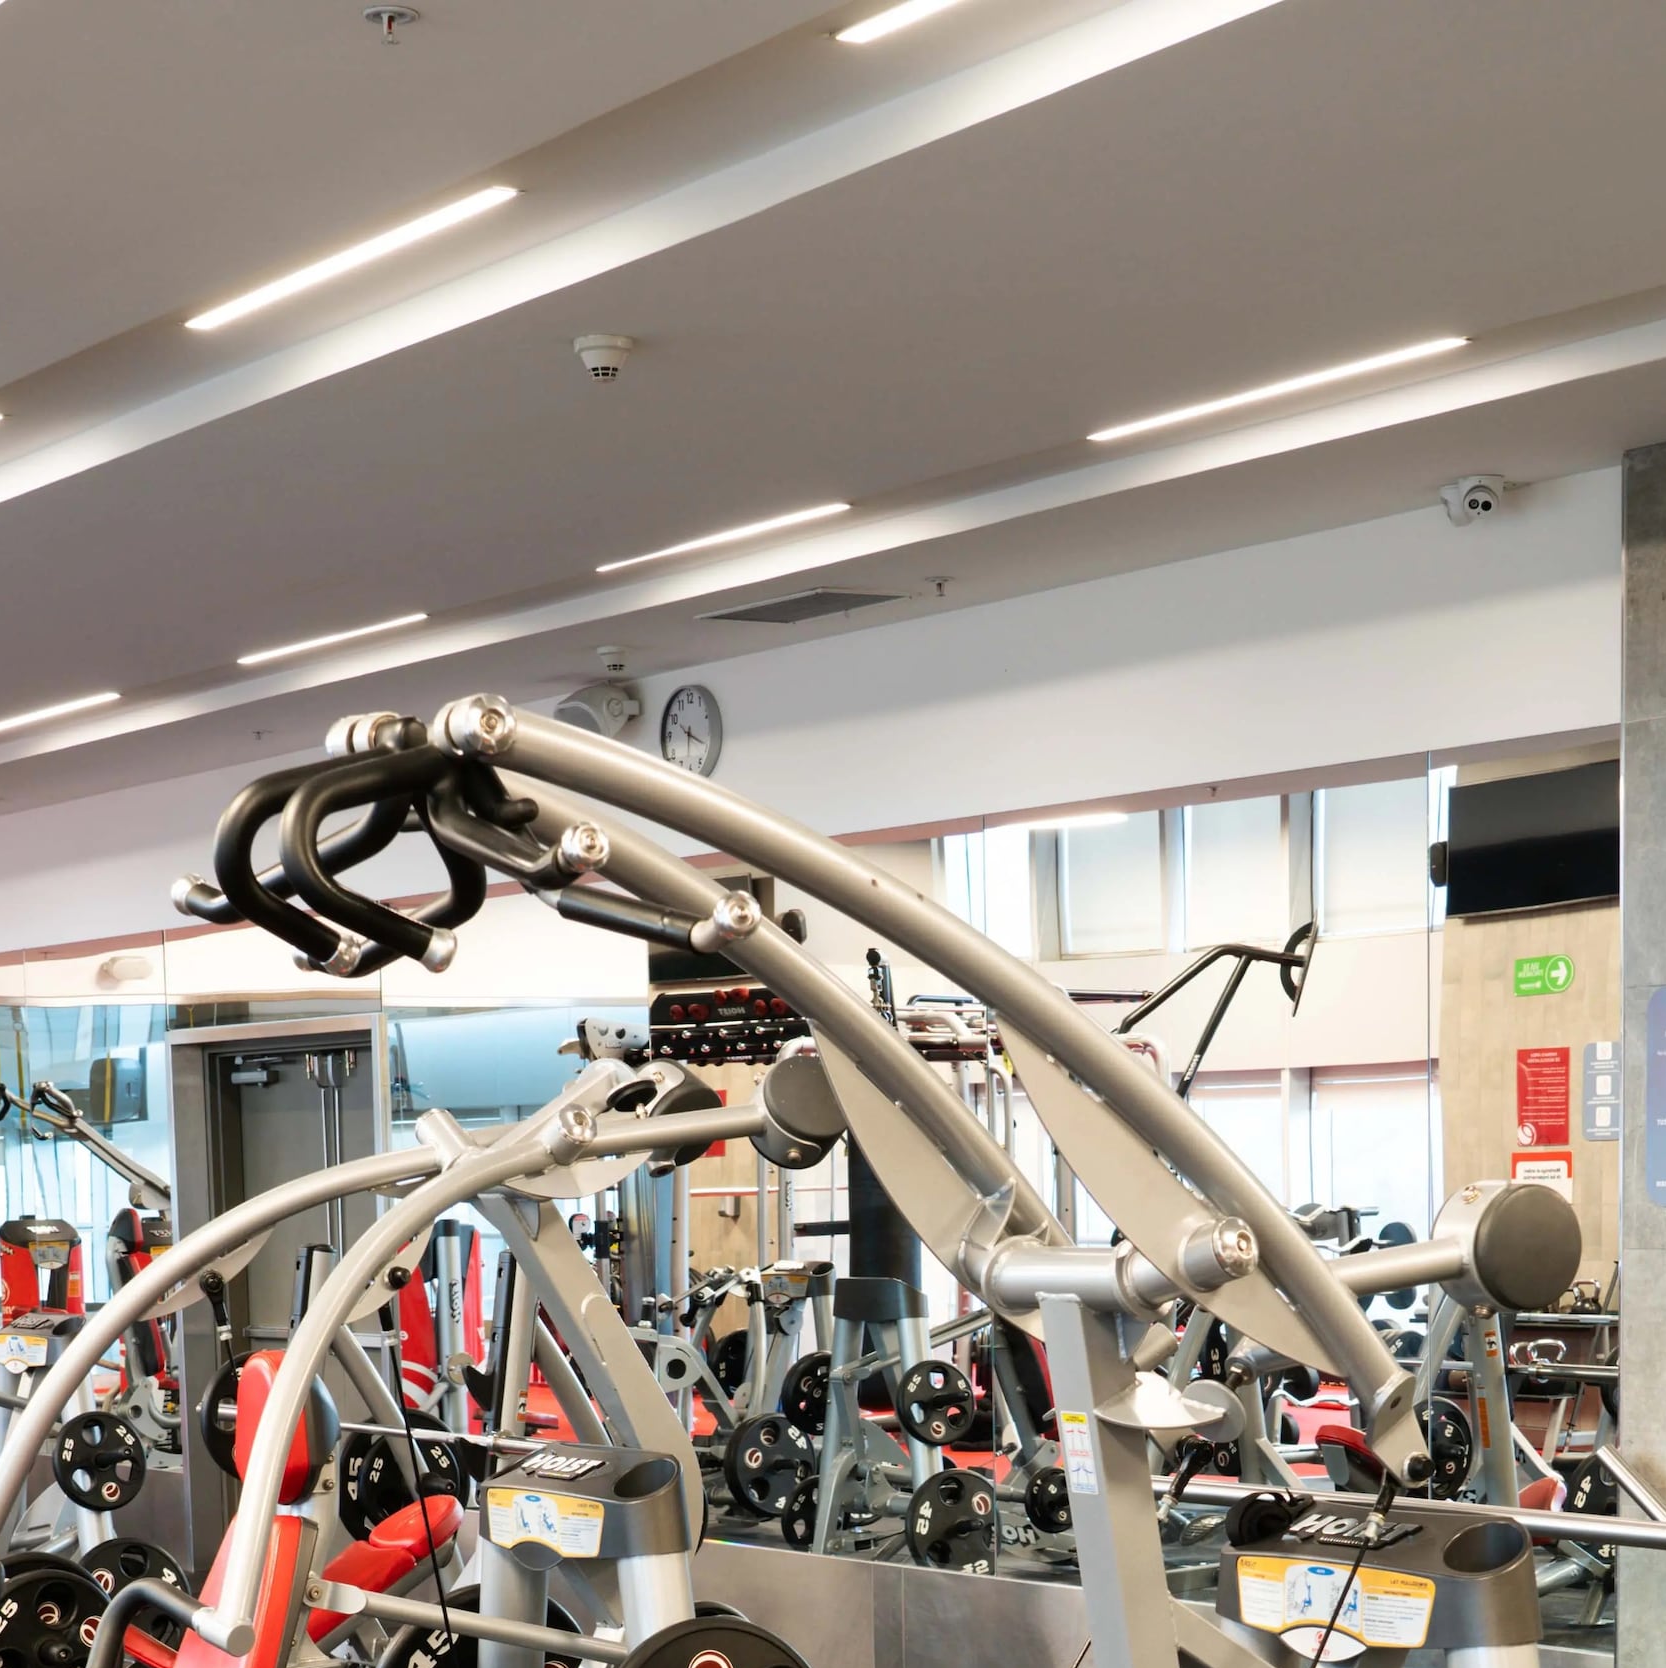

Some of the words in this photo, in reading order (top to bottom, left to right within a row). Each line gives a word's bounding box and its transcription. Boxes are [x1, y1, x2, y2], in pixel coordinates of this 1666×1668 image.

[115, 1424, 136, 1446] 25
[61, 1438, 75, 1462] 25
[430, 1446, 451, 1469] 25
[370, 1457, 385, 1484] 25
[523, 1453, 601, 1476] HOIST
[347, 1456, 363, 1501] 45
